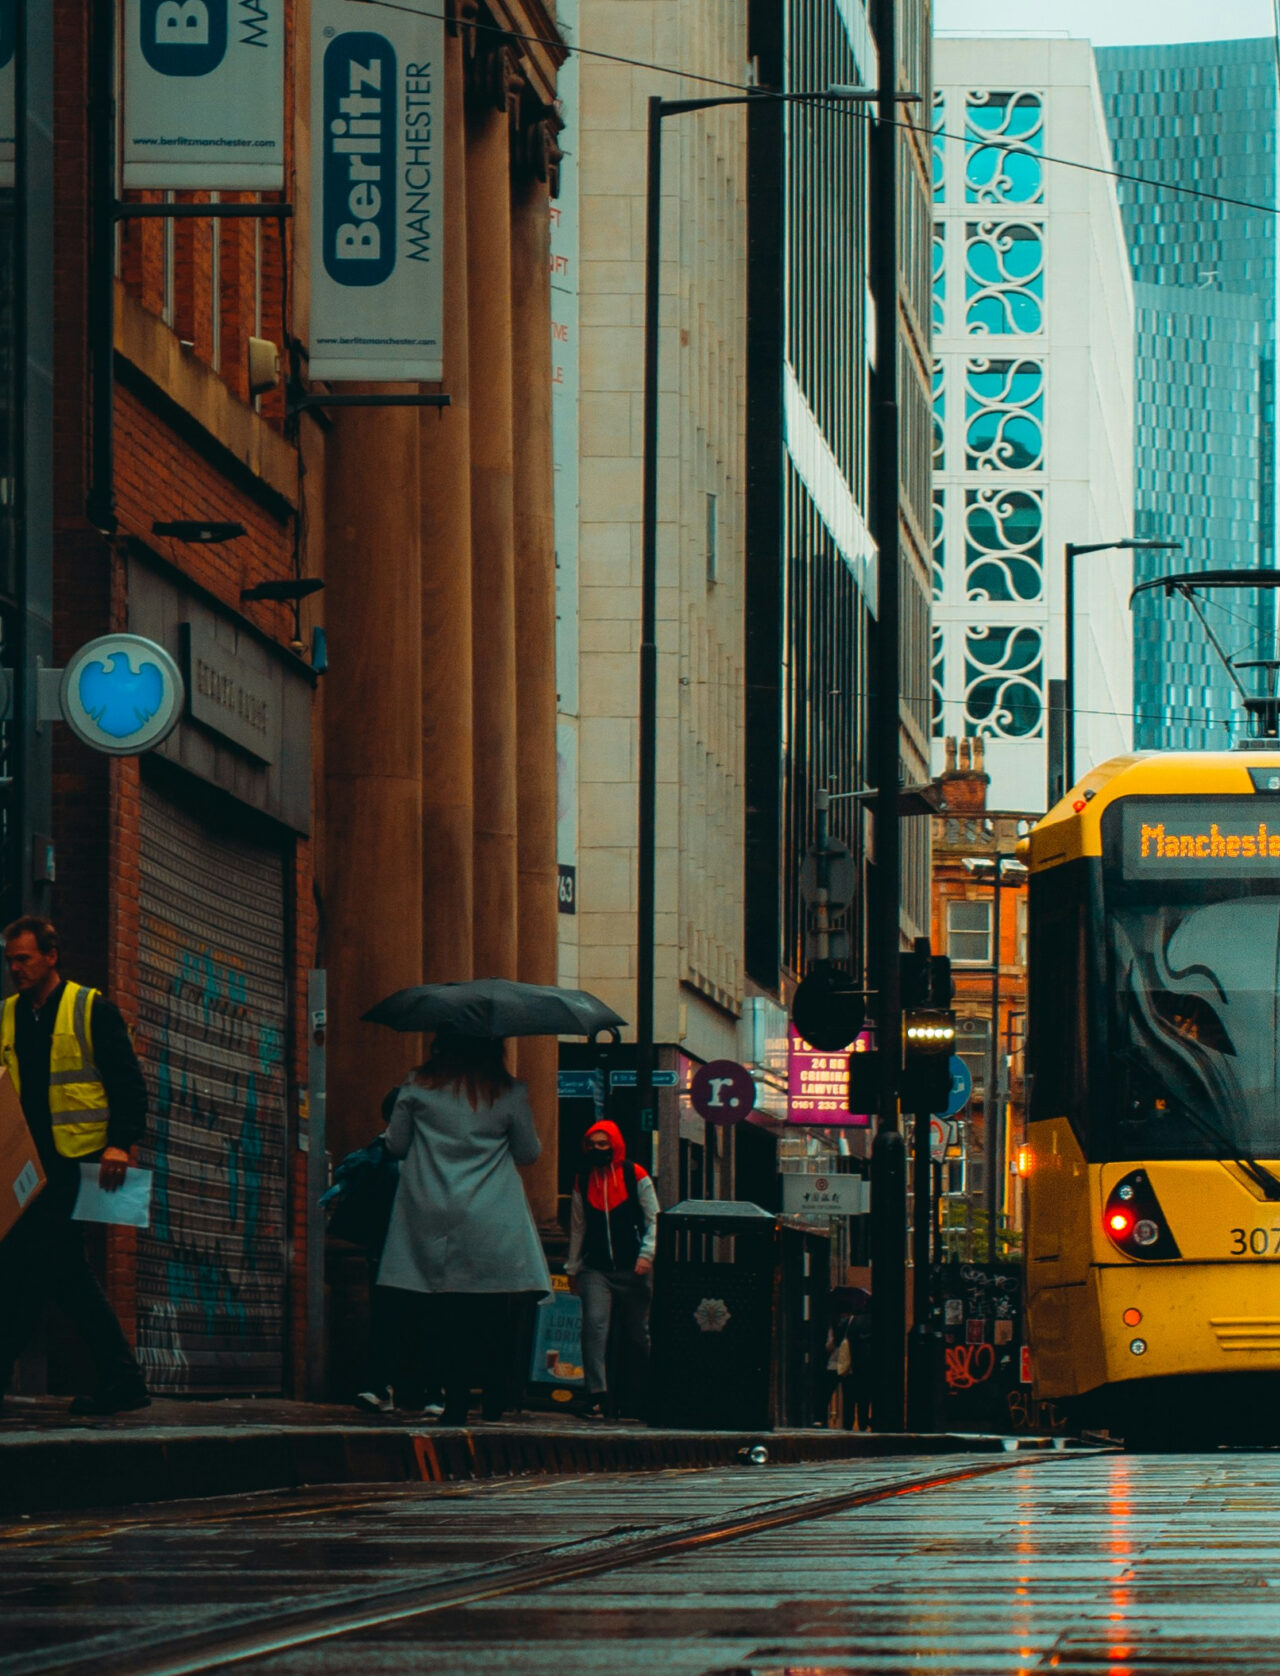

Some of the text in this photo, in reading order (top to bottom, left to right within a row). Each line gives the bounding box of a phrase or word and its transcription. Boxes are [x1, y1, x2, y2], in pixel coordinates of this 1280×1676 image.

[132, 136, 276, 148] www.berlitzmanchester.com
[331, 58, 382, 260] Berlitz
[405, 62, 431, 262] MANCHESTER
[316, 337, 437, 346] www.berlitzmanchester.com
[811, 1058, 827, 1070] 24
[800, 1070, 850, 1082] CRIMINA
[707, 1078, 739, 1107] r.
[801, 1083, 848, 1095] LAWYER
[549, 1315, 582, 1328] LUNC
